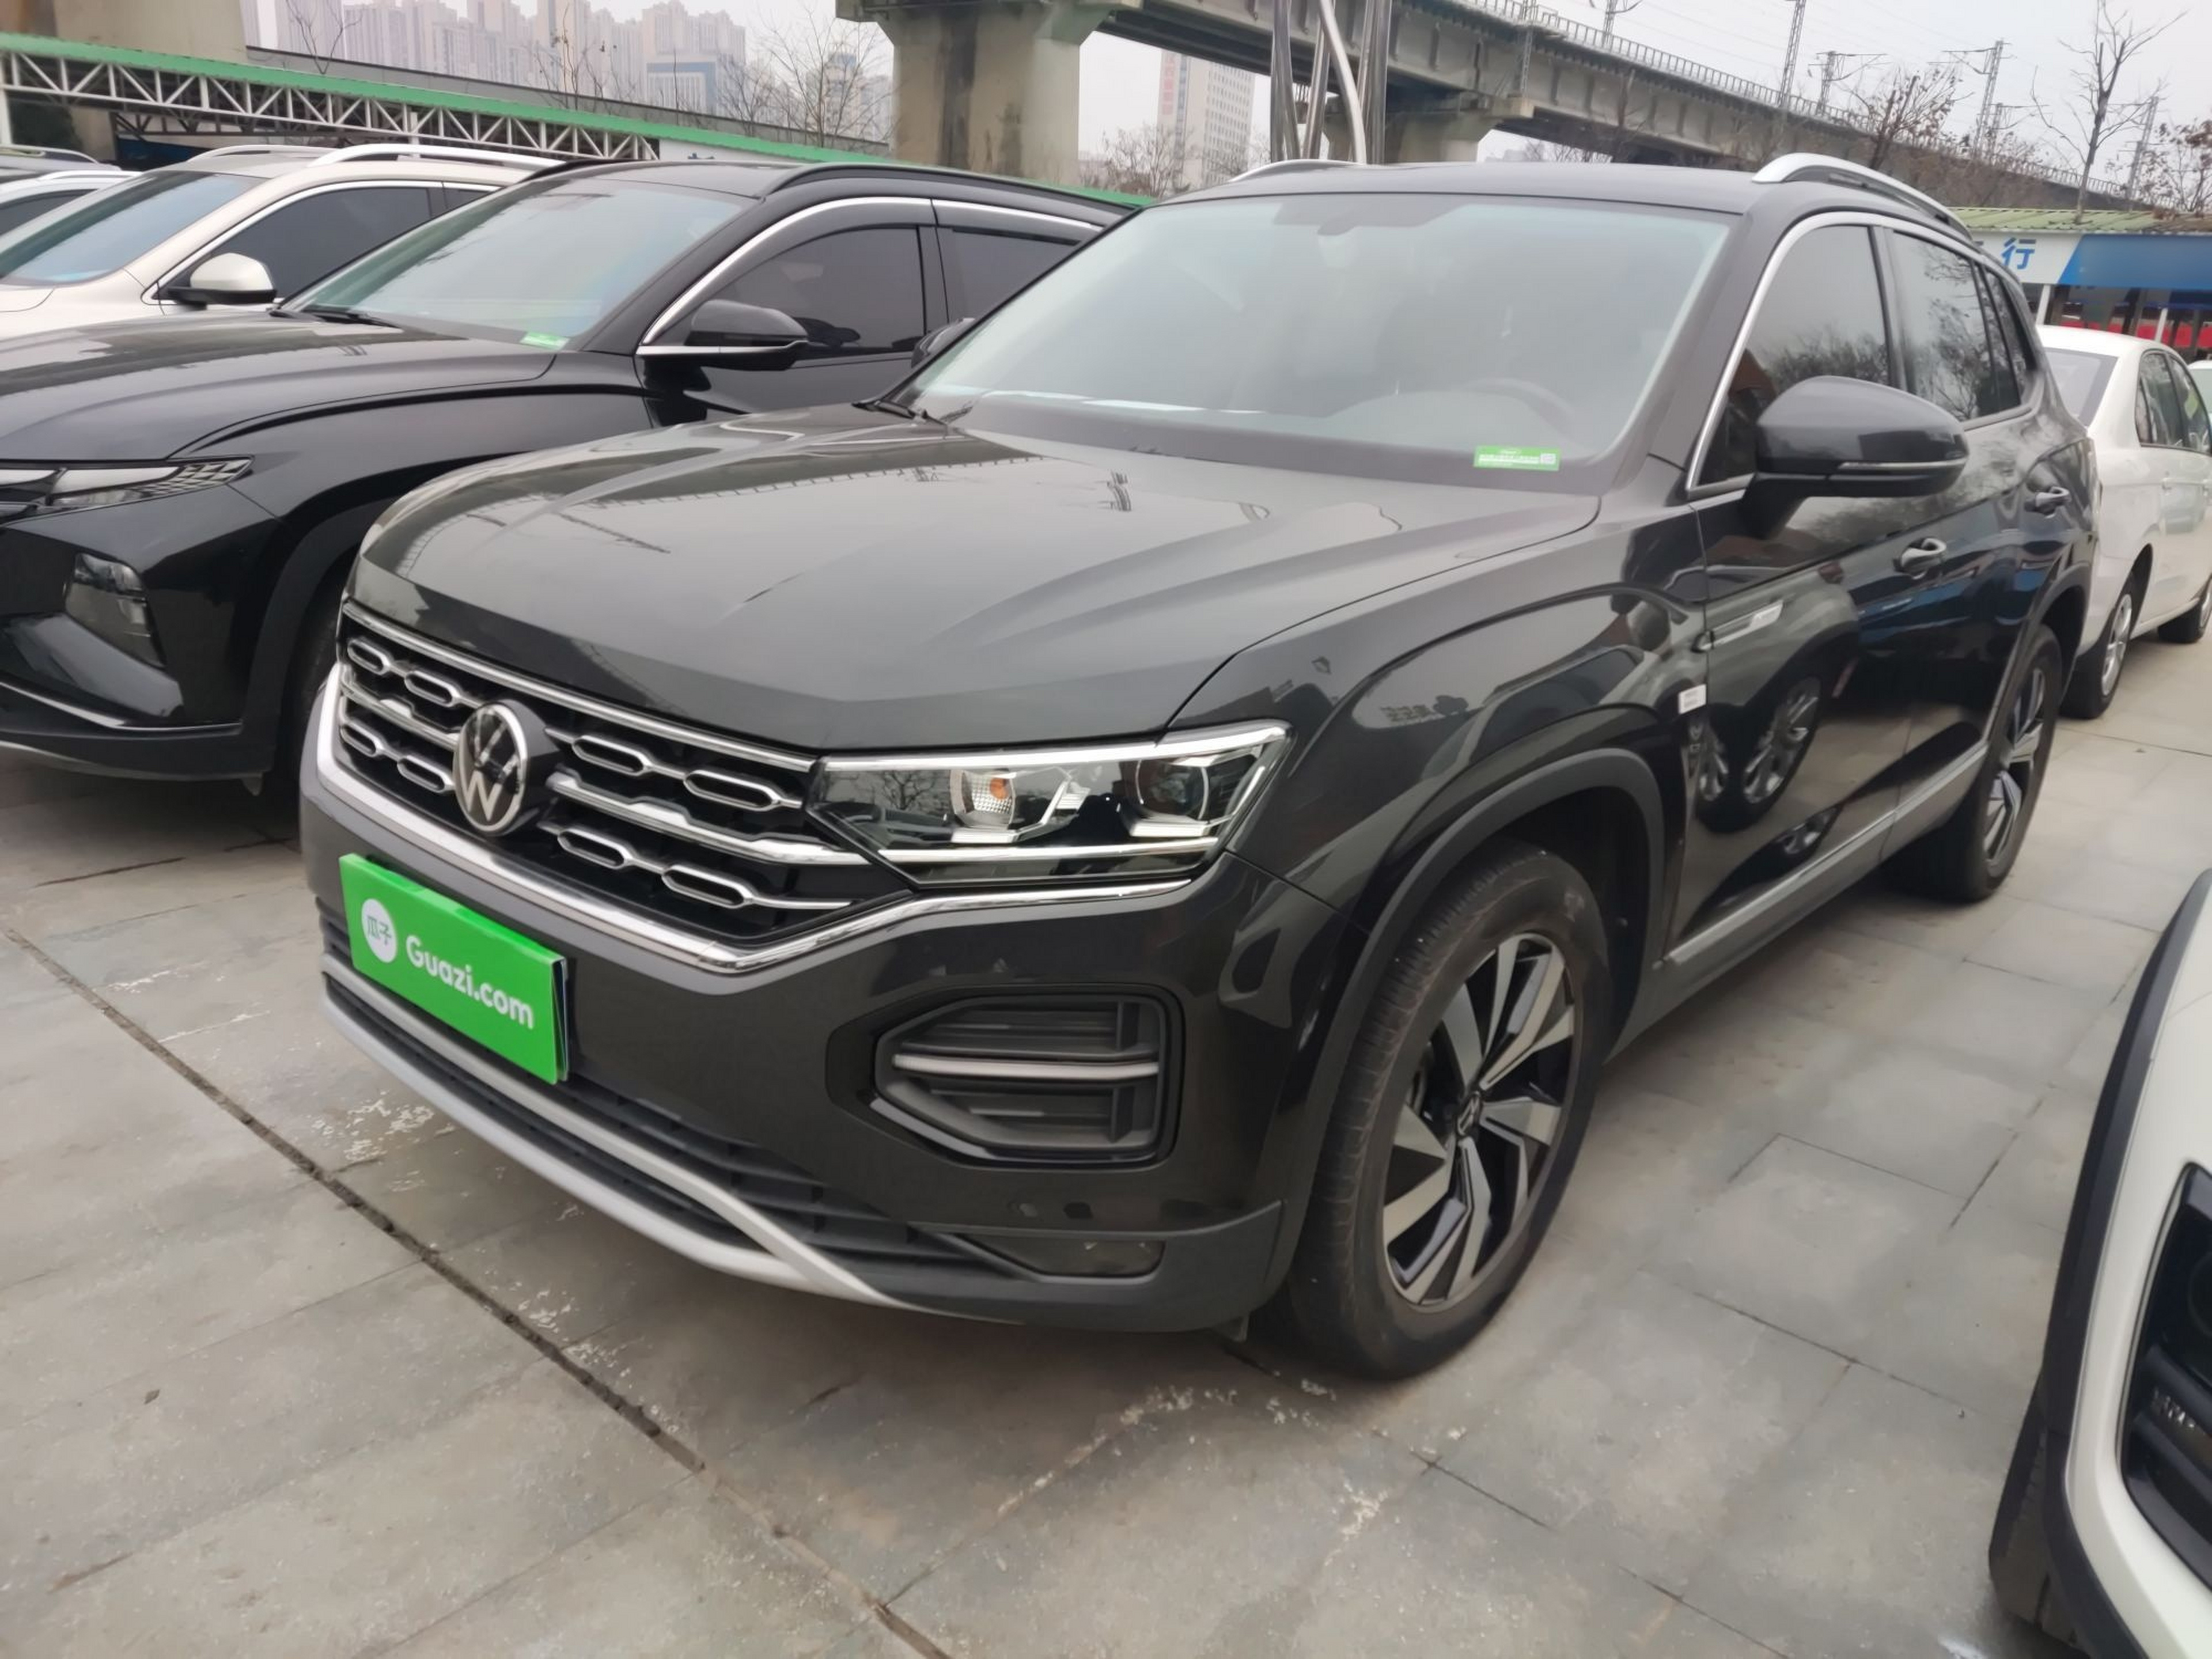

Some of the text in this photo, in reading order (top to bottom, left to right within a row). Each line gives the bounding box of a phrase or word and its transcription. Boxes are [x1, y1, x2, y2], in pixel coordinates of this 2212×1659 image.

[1974, 237, 2036, 270] 行
[463, 706, 522, 824] VW
[367, 915, 392, 945] 瓜子
[406, 934, 533, 1029] Guazi.com
